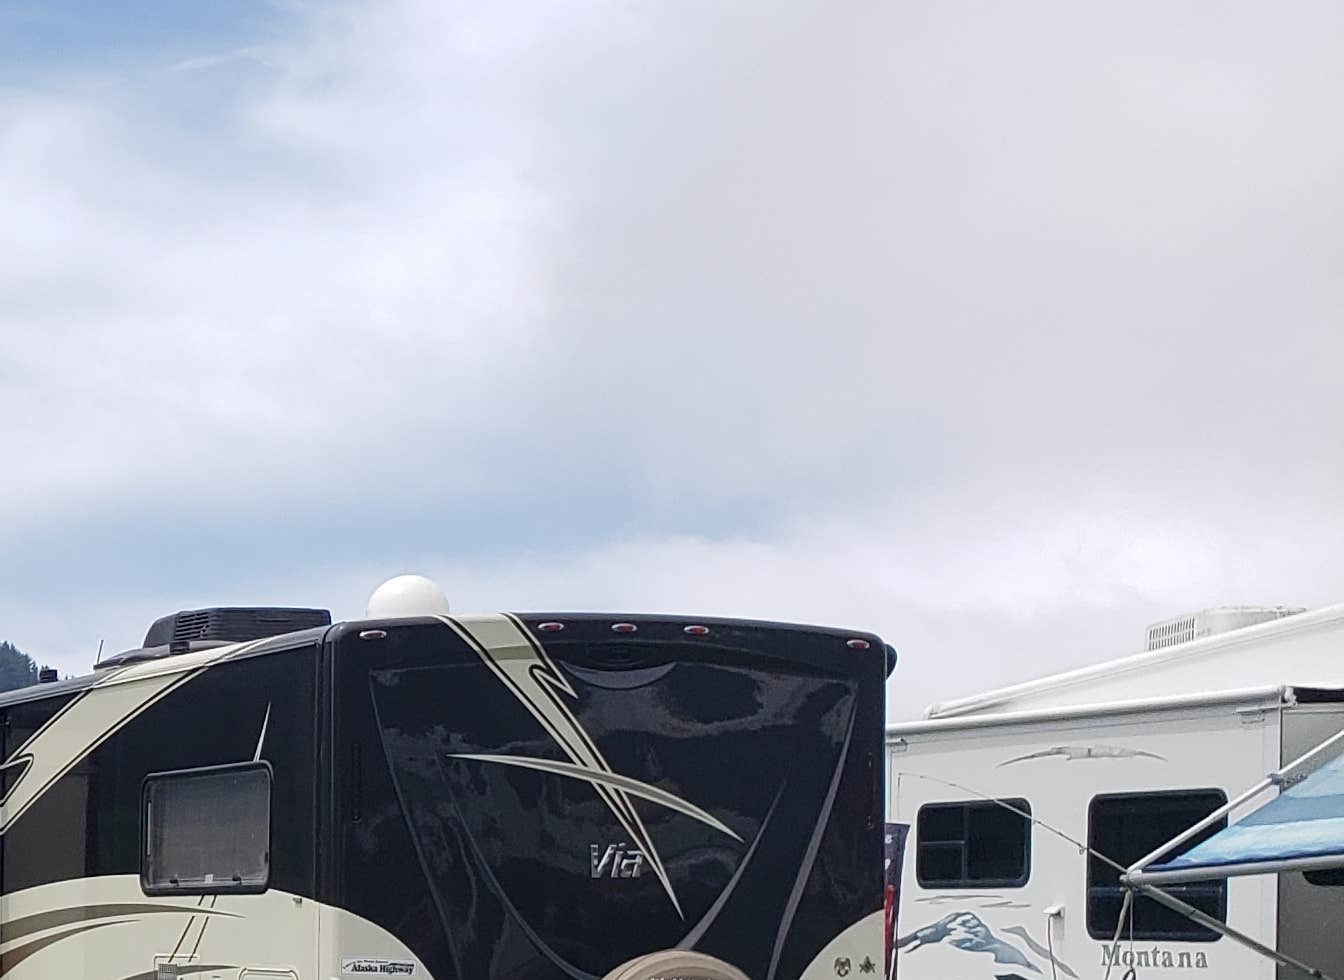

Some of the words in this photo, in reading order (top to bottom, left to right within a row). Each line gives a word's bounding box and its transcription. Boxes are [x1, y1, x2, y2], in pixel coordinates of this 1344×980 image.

[590, 843, 643, 878] Via
[1101, 944, 1208, 968] Montana
[351, 964, 378, 973] Alaska
[379, 964, 414, 975] Highway
